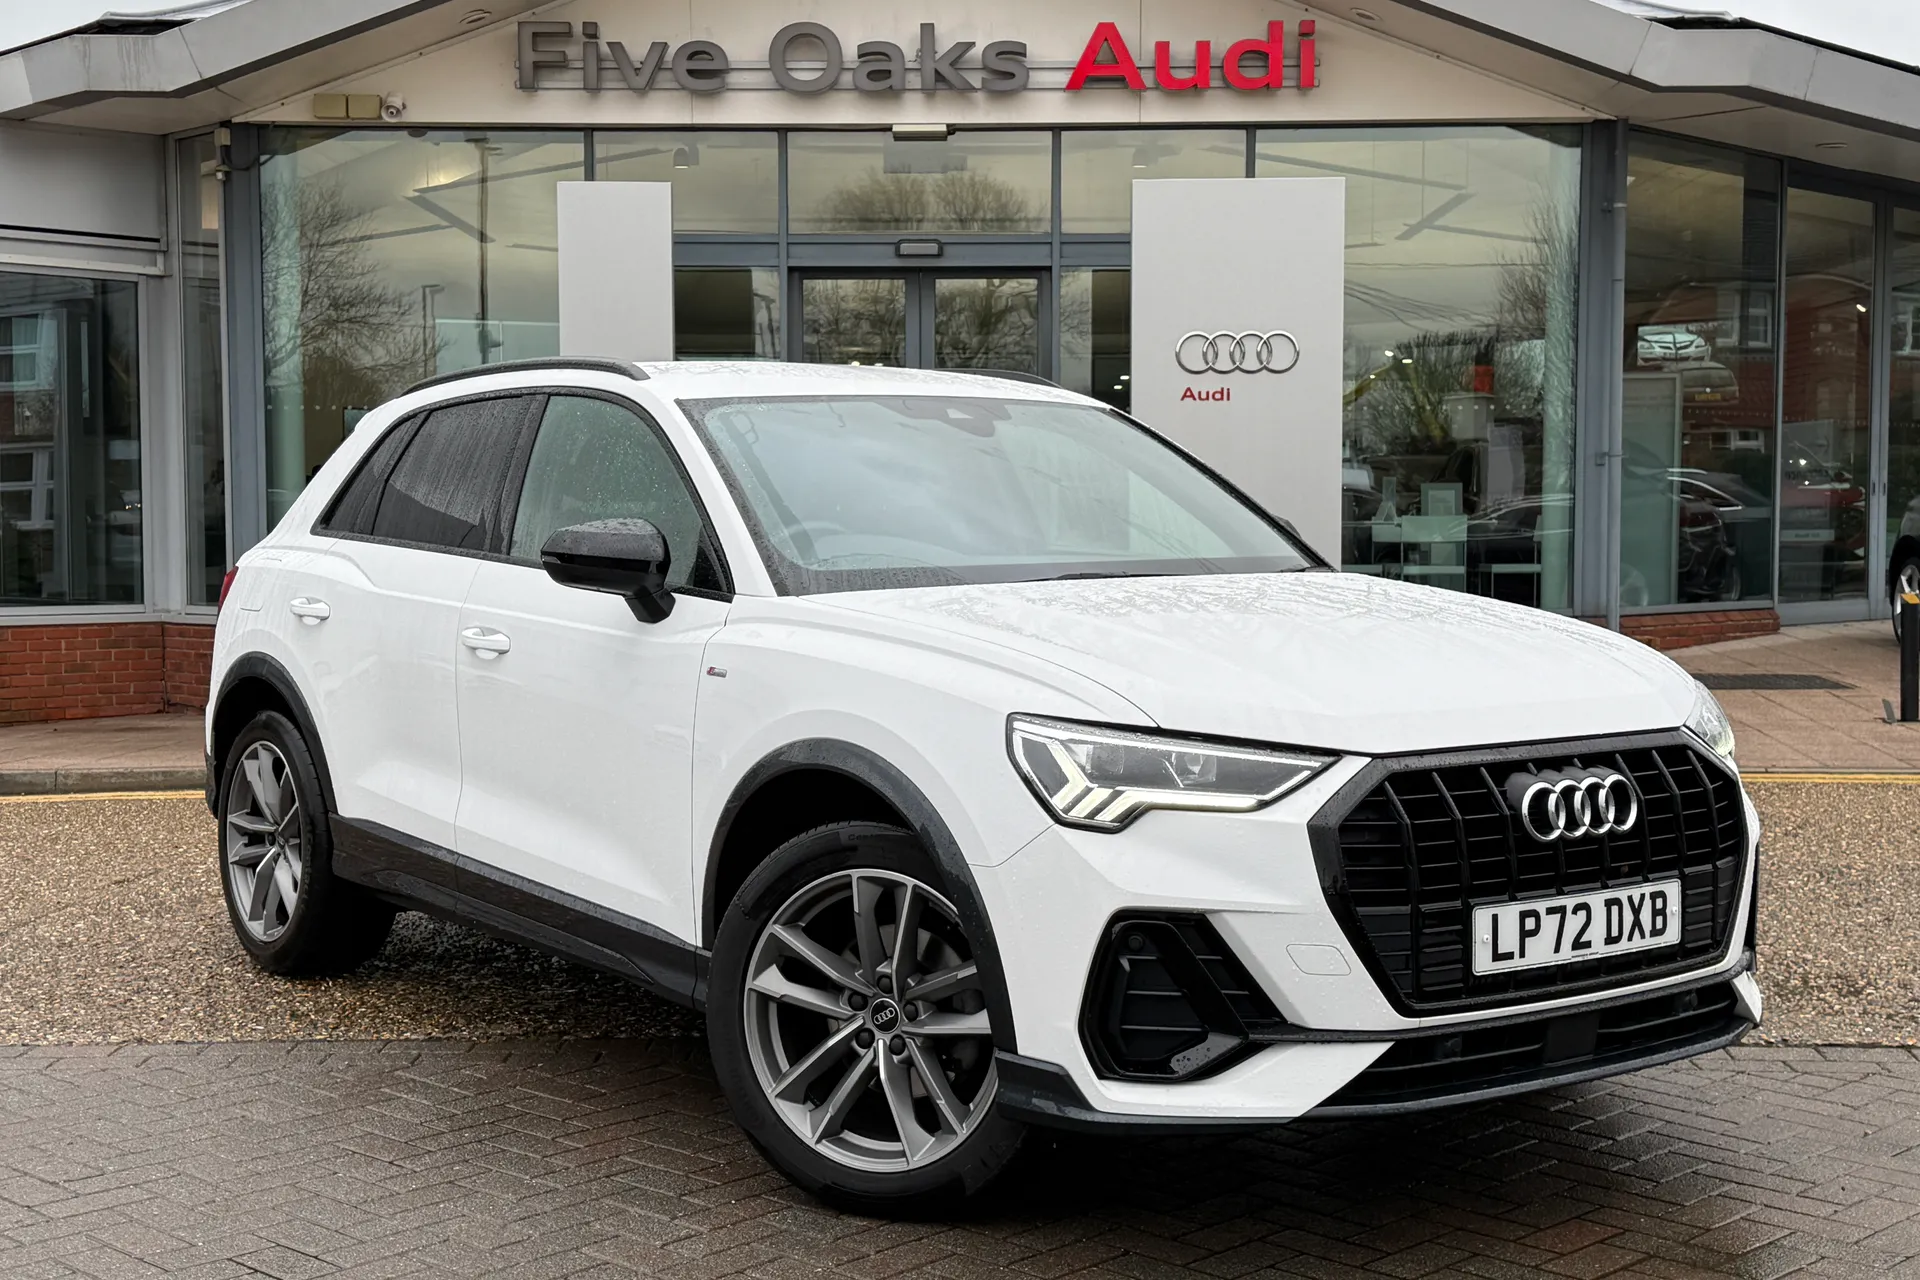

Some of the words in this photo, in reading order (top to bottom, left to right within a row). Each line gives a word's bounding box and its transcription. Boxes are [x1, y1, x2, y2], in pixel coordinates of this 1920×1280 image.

[517, 22, 729, 93] Five
[768, 22, 1028, 93] Oaks
[1065, 20, 1316, 91] Audi
[1180, 386, 1230, 401] Audi
[1491, 902, 1592, 962] LP72
[1604, 890, 1668, 945] DXB
